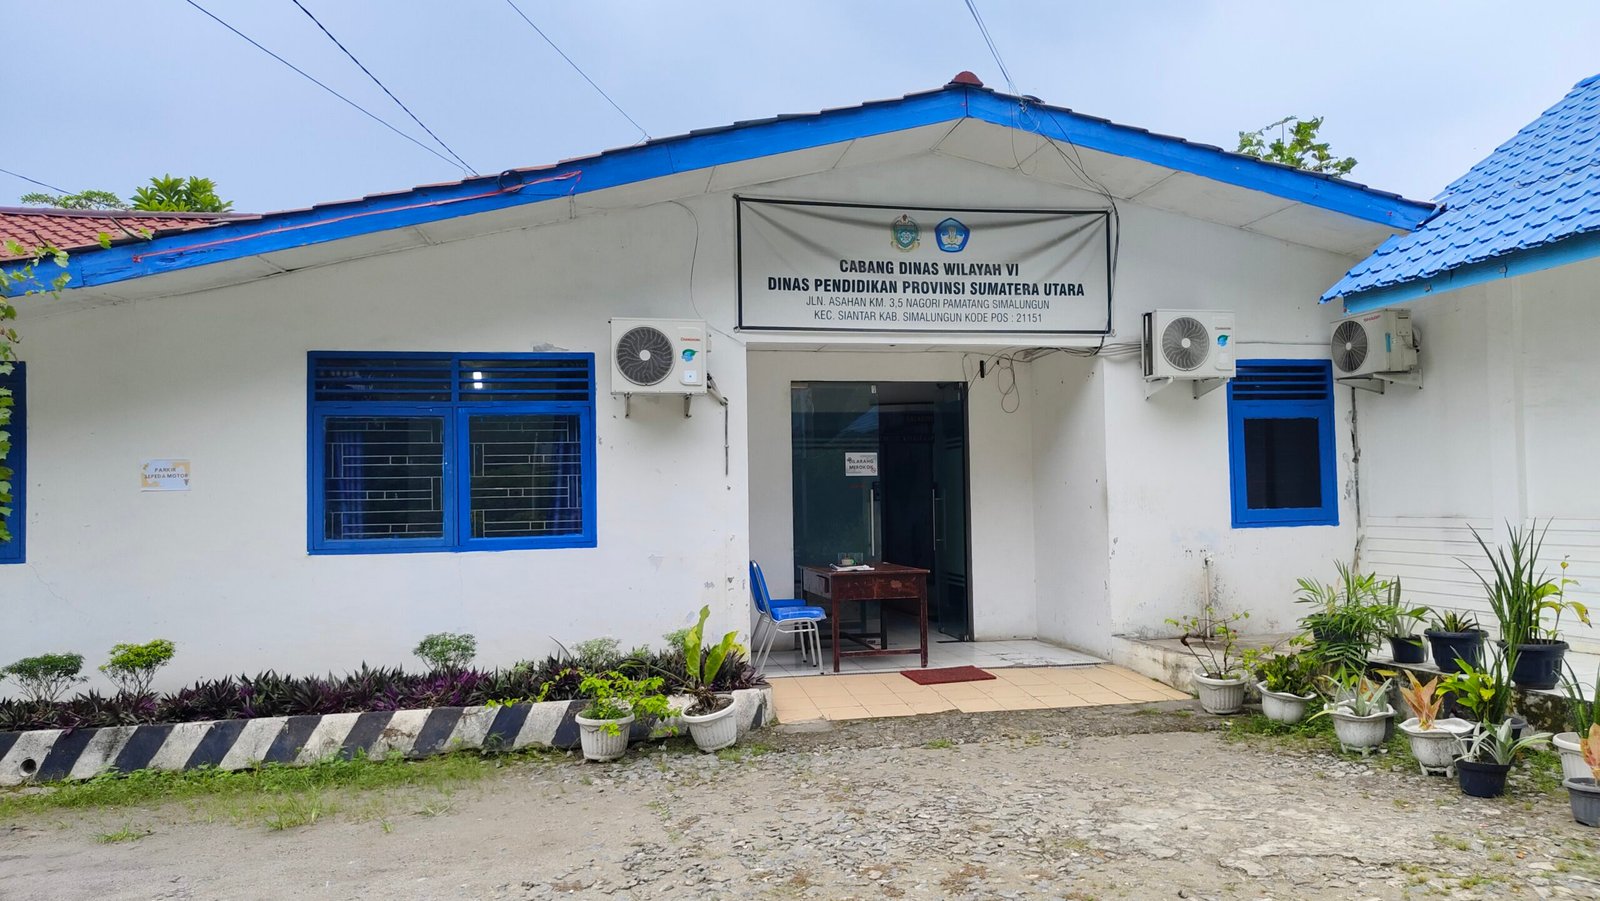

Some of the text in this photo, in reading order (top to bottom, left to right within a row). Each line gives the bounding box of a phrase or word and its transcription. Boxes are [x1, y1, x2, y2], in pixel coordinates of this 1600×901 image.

[840, 259, 1018, 276] CABANG DINAS WILAYAH VI
[768, 277, 1084, 296] DINAS PENDIDIKAN PROVINSI SUMATERA UTARA
[806, 296, 1050, 309] JLN. ASAHAN KM. 3,5 NAGORI PAMATANG SIMALUNGUN
[814, 310, 834, 320] KEC.
[838, 311, 876, 321] SIANTAR
[880, 312, 900, 321] KAB.
[903, 312, 962, 322] SIMALUNGUN
[965, 313, 988, 322] KODE
[991, 313, 1008, 322] POS
[1016, 313, 1042, 322] 21151
